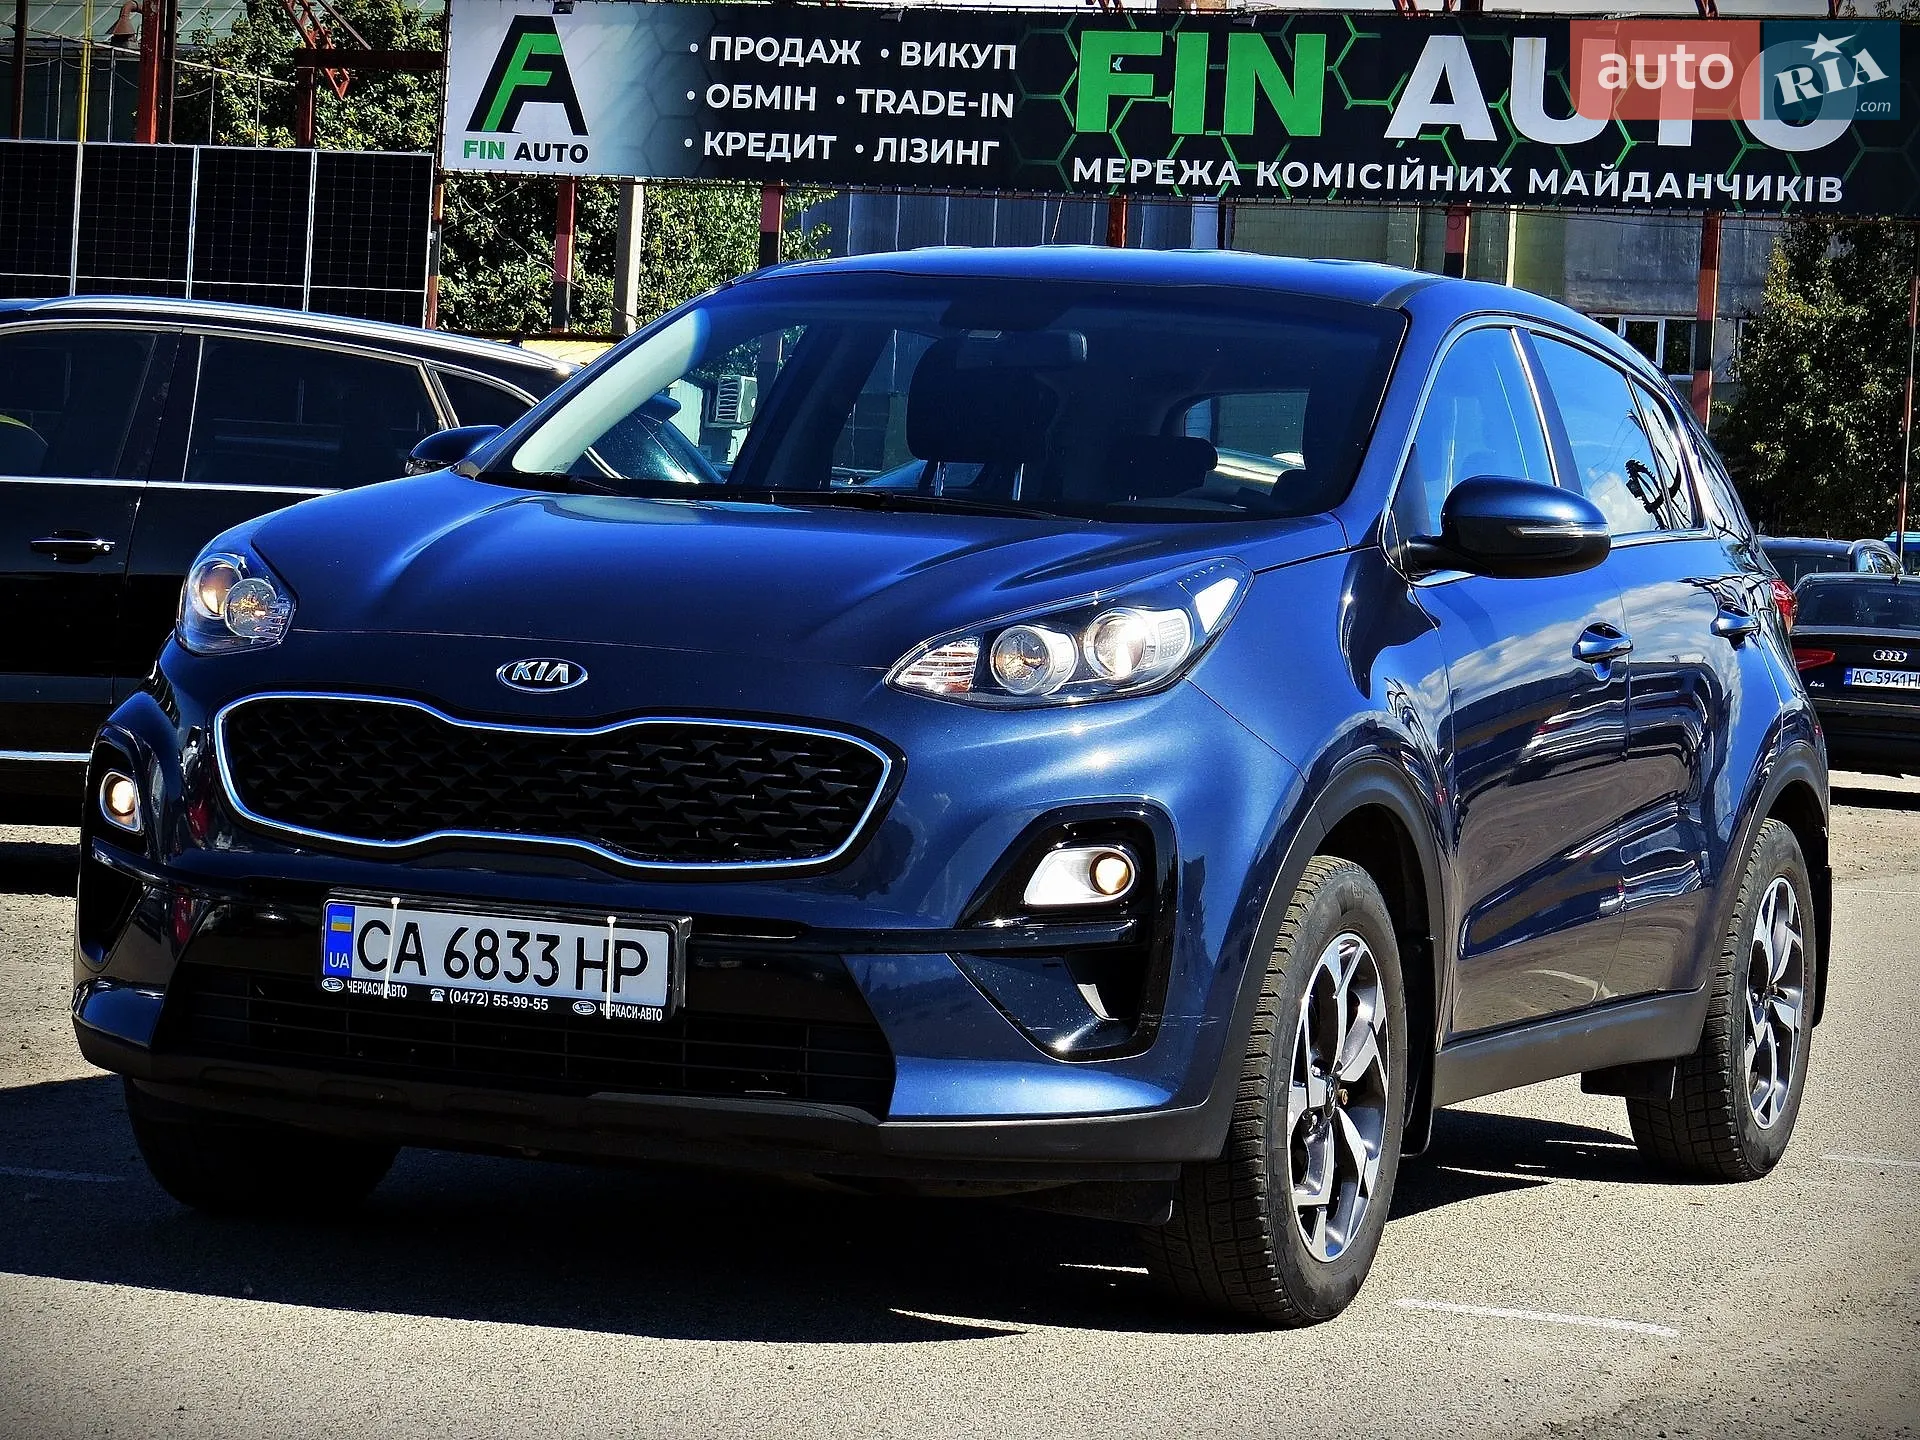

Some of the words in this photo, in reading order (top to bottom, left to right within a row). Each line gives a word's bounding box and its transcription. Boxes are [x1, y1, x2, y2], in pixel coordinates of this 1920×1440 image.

[708, 36, 861, 67] ПРОДАЖ
[899, 41, 1017, 71] ВИКУП
[705, 82, 817, 112] ОБМІН
[855, 87, 1015, 119] TRADE-IN
[1075, 30, 1327, 137] FIN
[1383, 35, 1861, 152] AUTO
[463, 140, 505, 160] FIN
[513, 142, 589, 164] AUTO
[703, 131, 838, 162] КРЕДИТ
[873, 138, 1000, 168] ЛІЗИНГ
[1073, 157, 1241, 186] МЕРЕЖА
[1256, 157, 1511, 193] КОМІСІЙНИХ
[1526, 163, 1844, 203] МАЙДАНЧИКІВ
[511, 661, 569, 684] KIA
[1853, 670, 1874, 684] AC
[329, 951, 350, 970] UA
[356, 919, 428, 977] CA
[442, 926, 561, 988] 6833
[575, 936, 649, 994] HP
[449, 988, 489, 1007] (0472)
[492, 993, 549, 1012] 55-99-55
